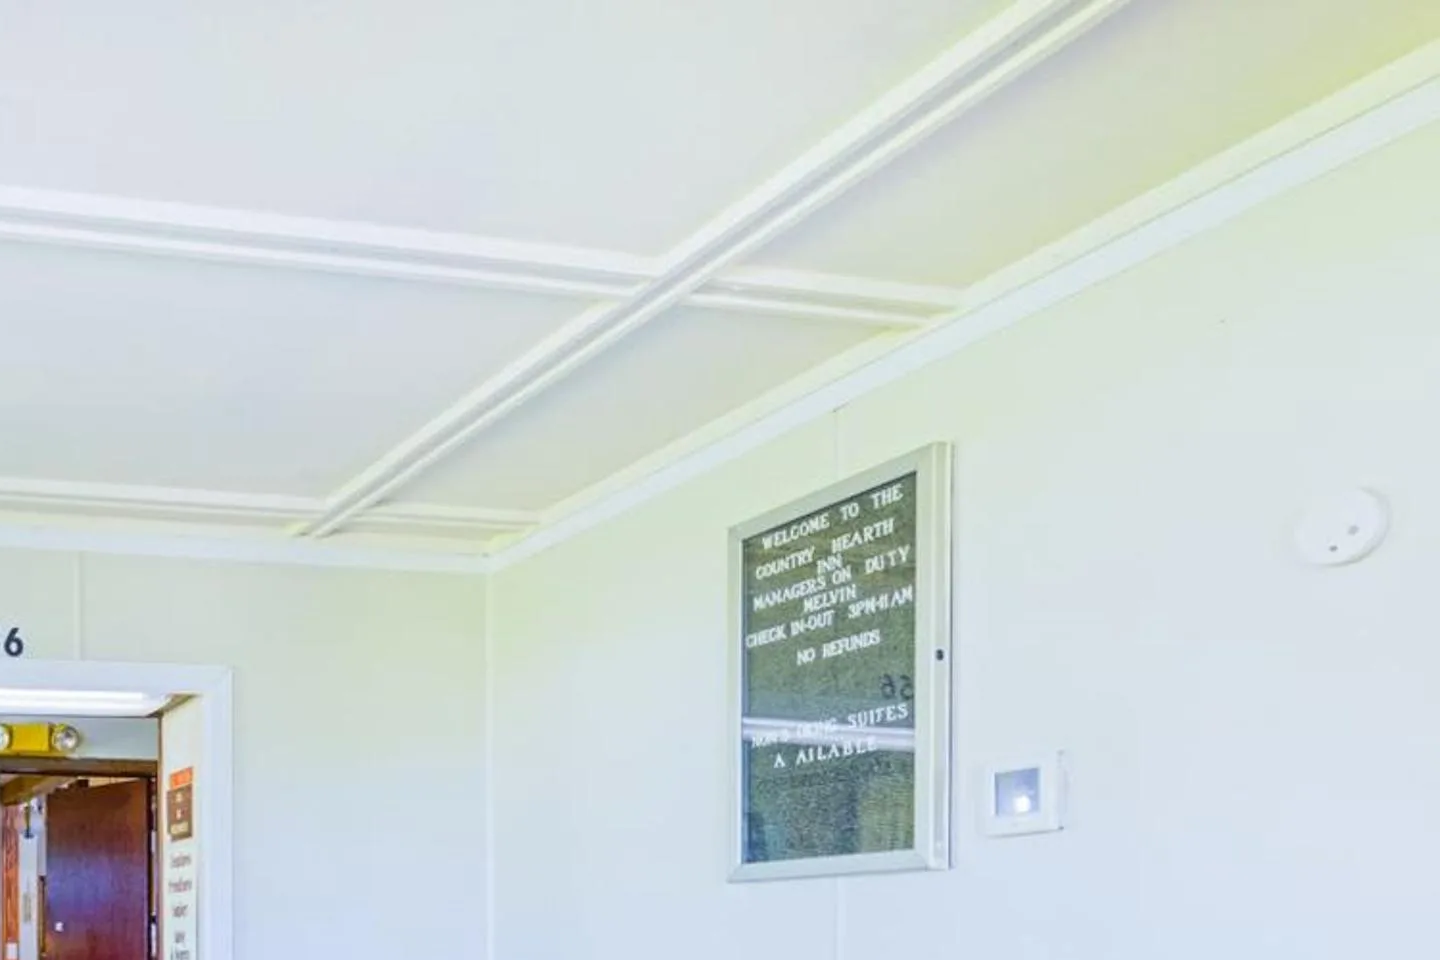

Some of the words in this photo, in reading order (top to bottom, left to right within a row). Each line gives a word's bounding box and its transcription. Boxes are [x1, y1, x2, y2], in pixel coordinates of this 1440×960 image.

[762, 513, 830, 550] WELCOME
[840, 502, 859, 521] TO
[869, 483, 904, 509] THE
[755, 546, 815, 580] COUNTRY
[831, 517, 895, 553] HEARTH
[816, 553, 843, 575] INN
[753, 576, 826, 612] MANAGERS
[832, 564, 852, 586] ON
[864, 544, 910, 575] DUTY
[803, 584, 858, 612] MELVIN
[745, 624, 787, 648] CHECK
[790, 610, 835, 636] IN-OUT
[796, 647, 816, 665] NO
[822, 629, 881, 659] REFUNDS
[847, 703, 909, 728] SUITES
